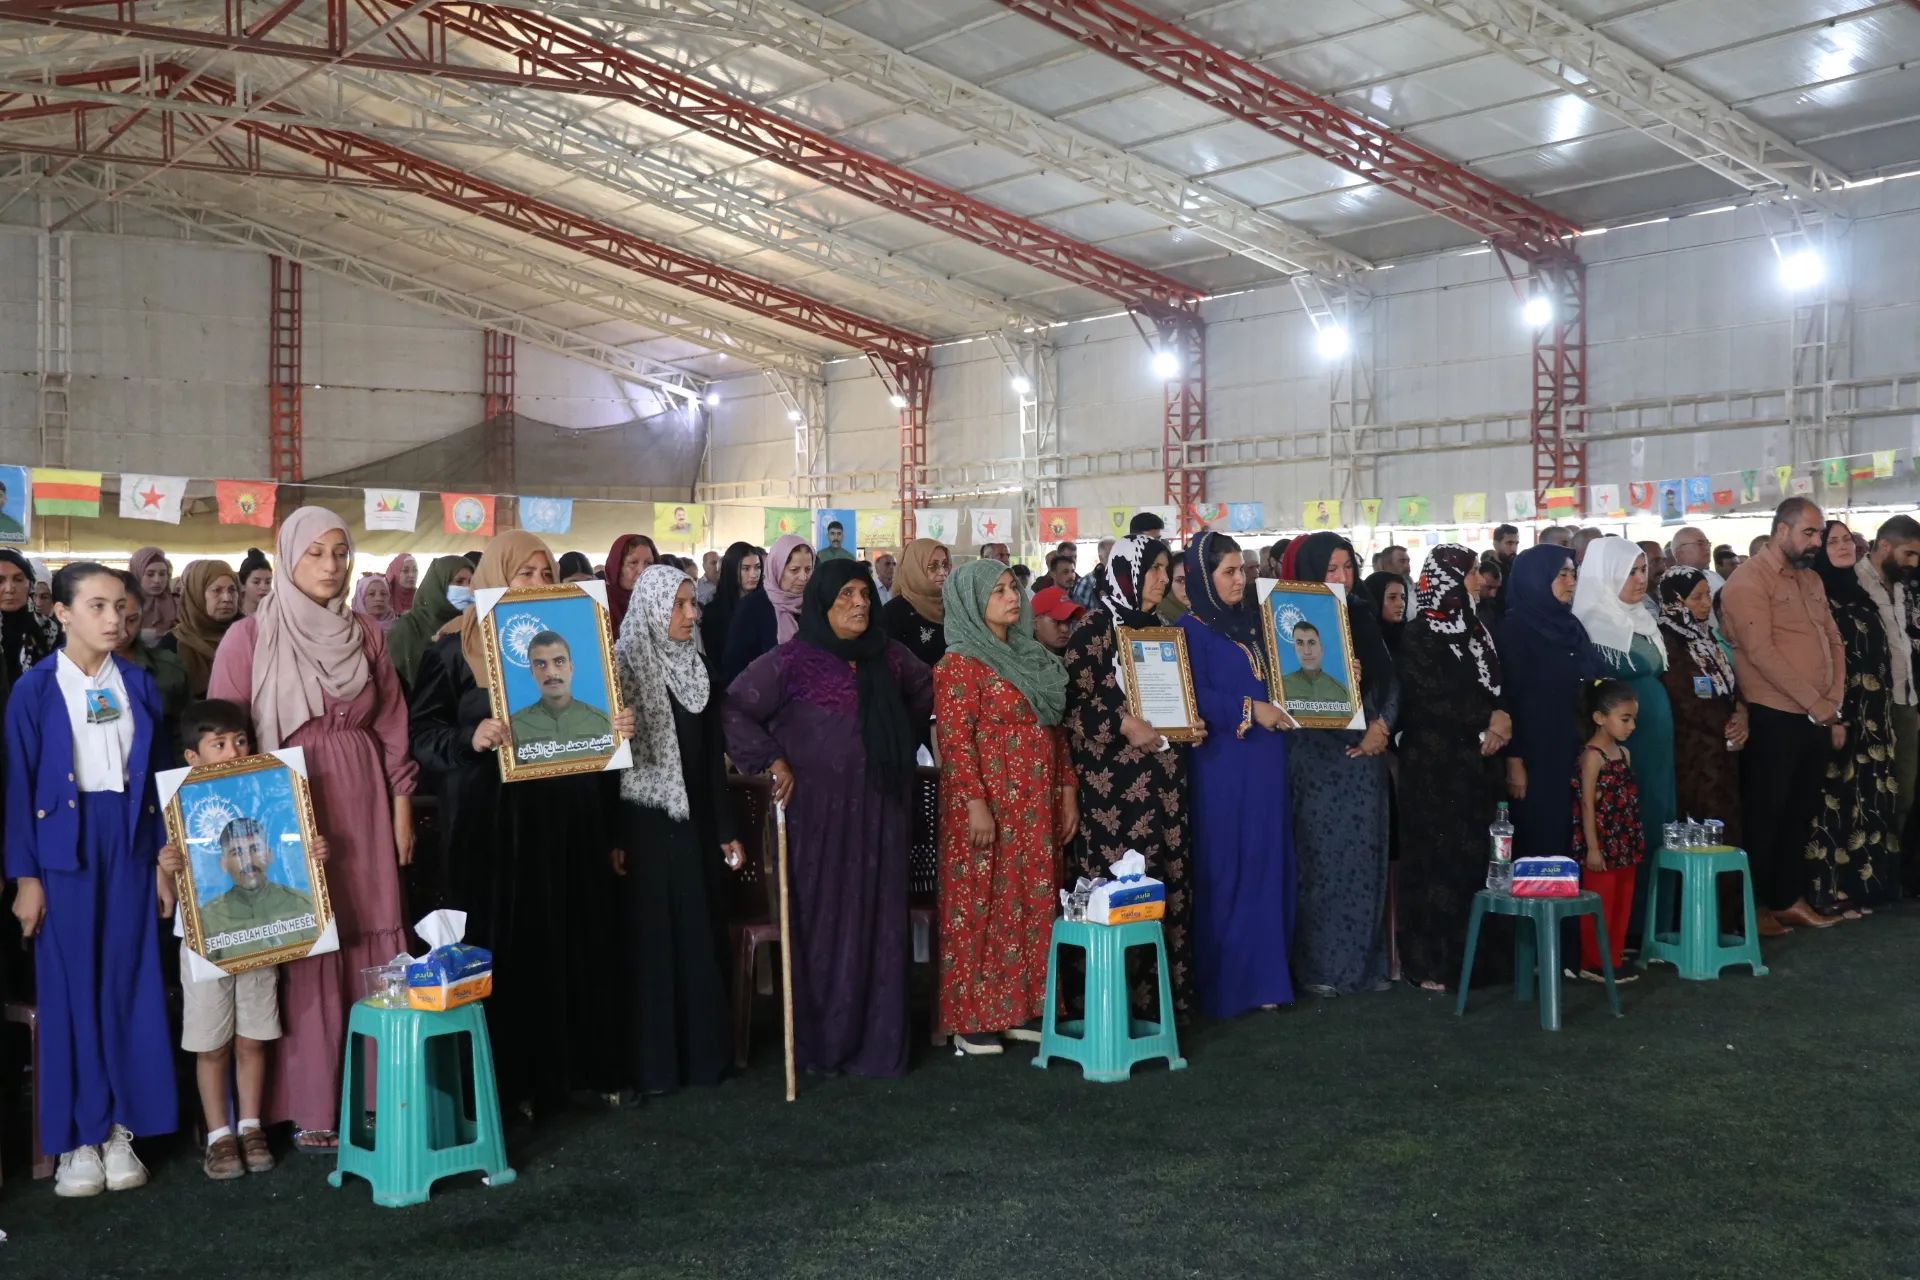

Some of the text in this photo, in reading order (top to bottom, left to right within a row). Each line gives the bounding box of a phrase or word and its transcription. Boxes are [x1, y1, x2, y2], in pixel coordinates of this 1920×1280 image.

[543, 741, 565, 757] صالح
[566, 741, 588, 751] محمد
[232, 928, 261, 945] SELAH
[262, 920, 288, 938] ELDÎN
[289, 913, 317, 932] HESÊN
